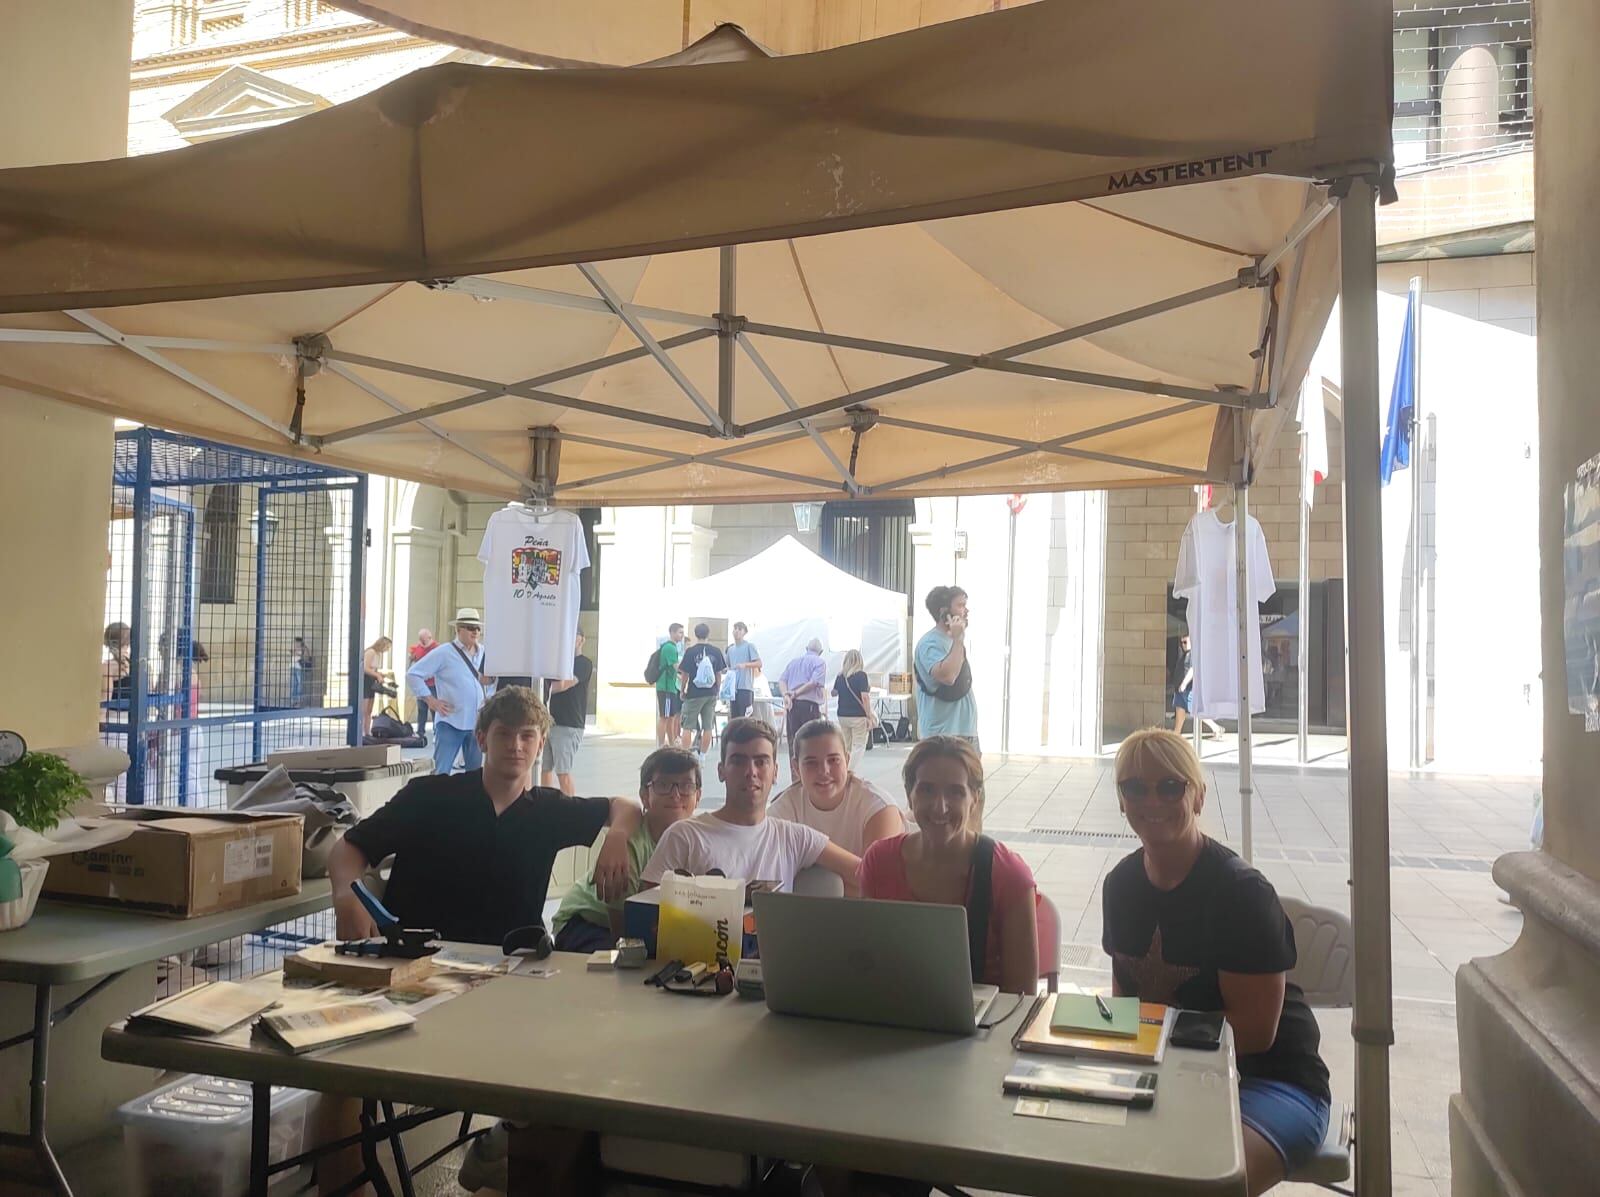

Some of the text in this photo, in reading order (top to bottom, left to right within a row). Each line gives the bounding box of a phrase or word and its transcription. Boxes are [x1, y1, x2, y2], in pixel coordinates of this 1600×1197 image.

[1107, 149, 1273, 191] MASTERTENT
[524, 535, 549, 547] Peña
[513, 588, 525, 599] 10
